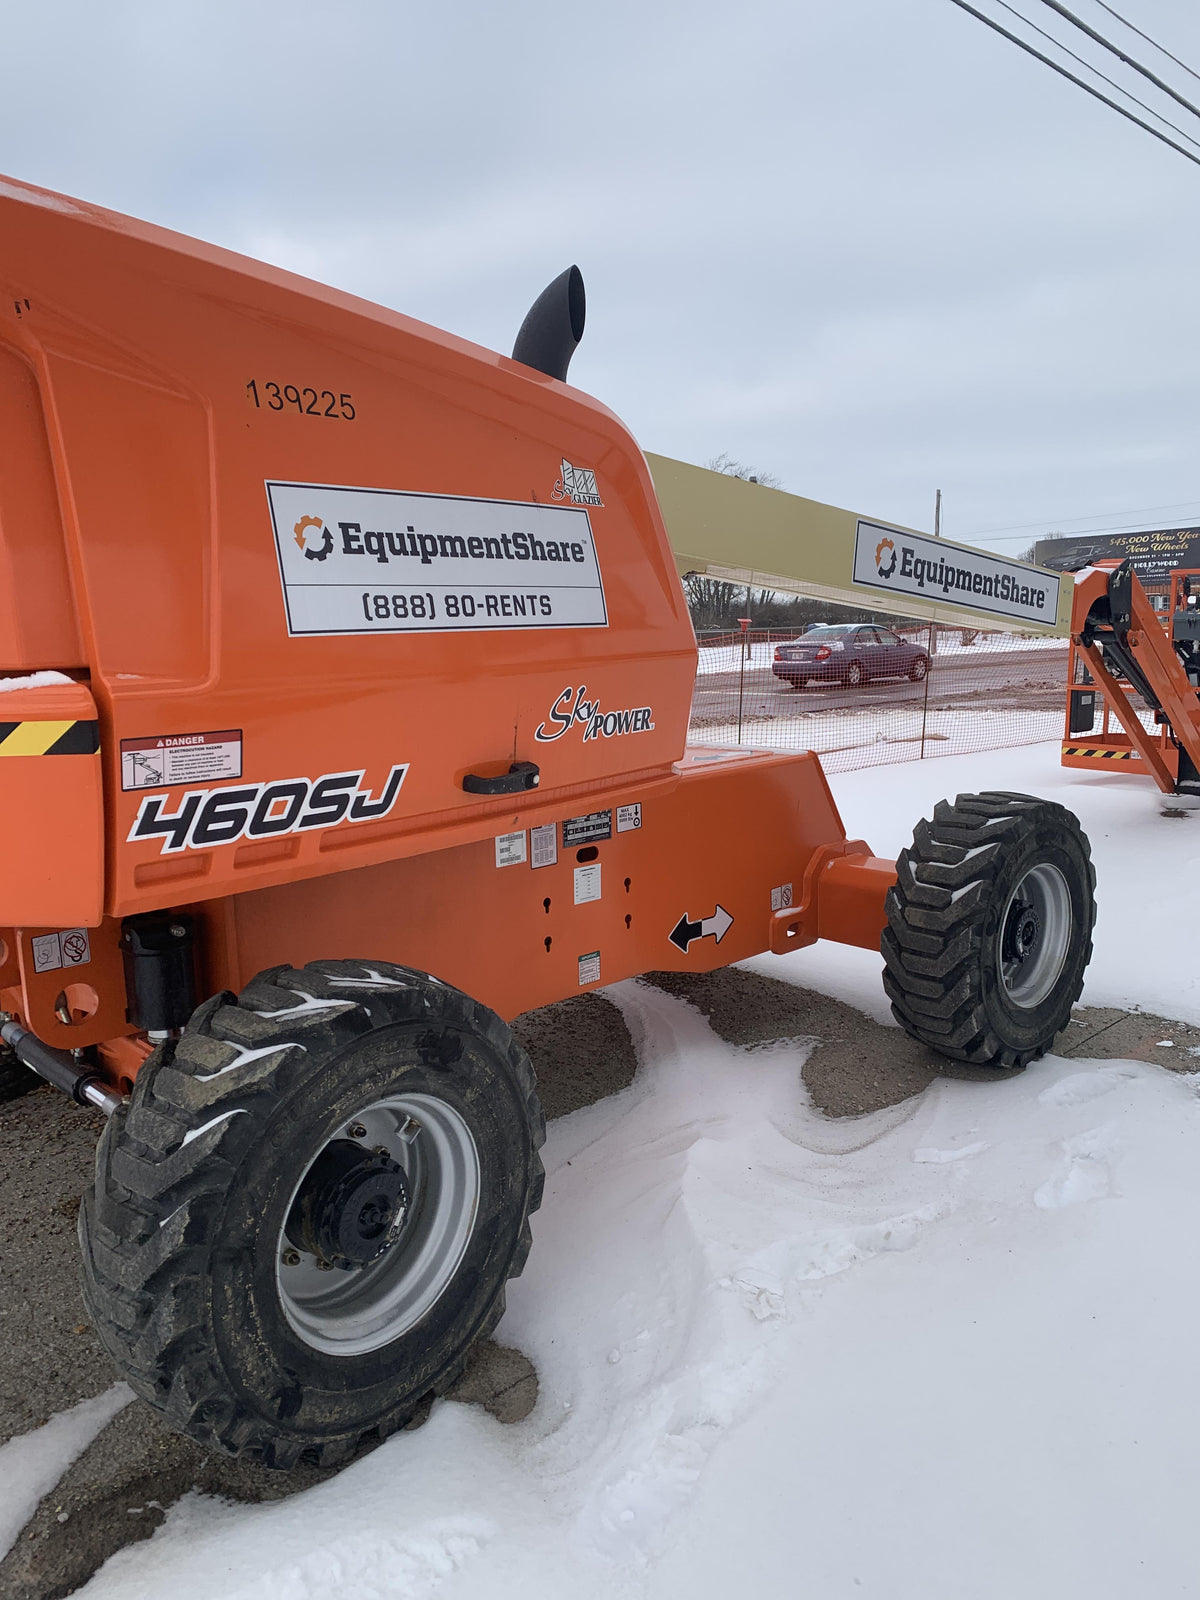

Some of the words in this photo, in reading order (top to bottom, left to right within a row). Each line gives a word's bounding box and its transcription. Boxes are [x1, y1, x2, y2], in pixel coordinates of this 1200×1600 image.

[246, 379, 356, 421] 139225
[573, 493, 603, 507] GLAZIER
[337, 521, 586, 565] EquipmentShare
[1125, 544, 1149, 554] New
[1150, 540, 1189, 552] Wheels
[1150, 532, 1175, 542] New
[899, 546, 1046, 610] EquipmentShare
[1133, 560, 1180, 569] HOLLYWOOD
[361, 592, 436, 622] (888)
[443, 594, 553, 618] 80-RENTS
[534, 685, 600, 743] Sky
[590, 706, 653, 739] POWER
[165, 736, 205, 747] DANGER
[127, 763, 410, 854] 460SJ
